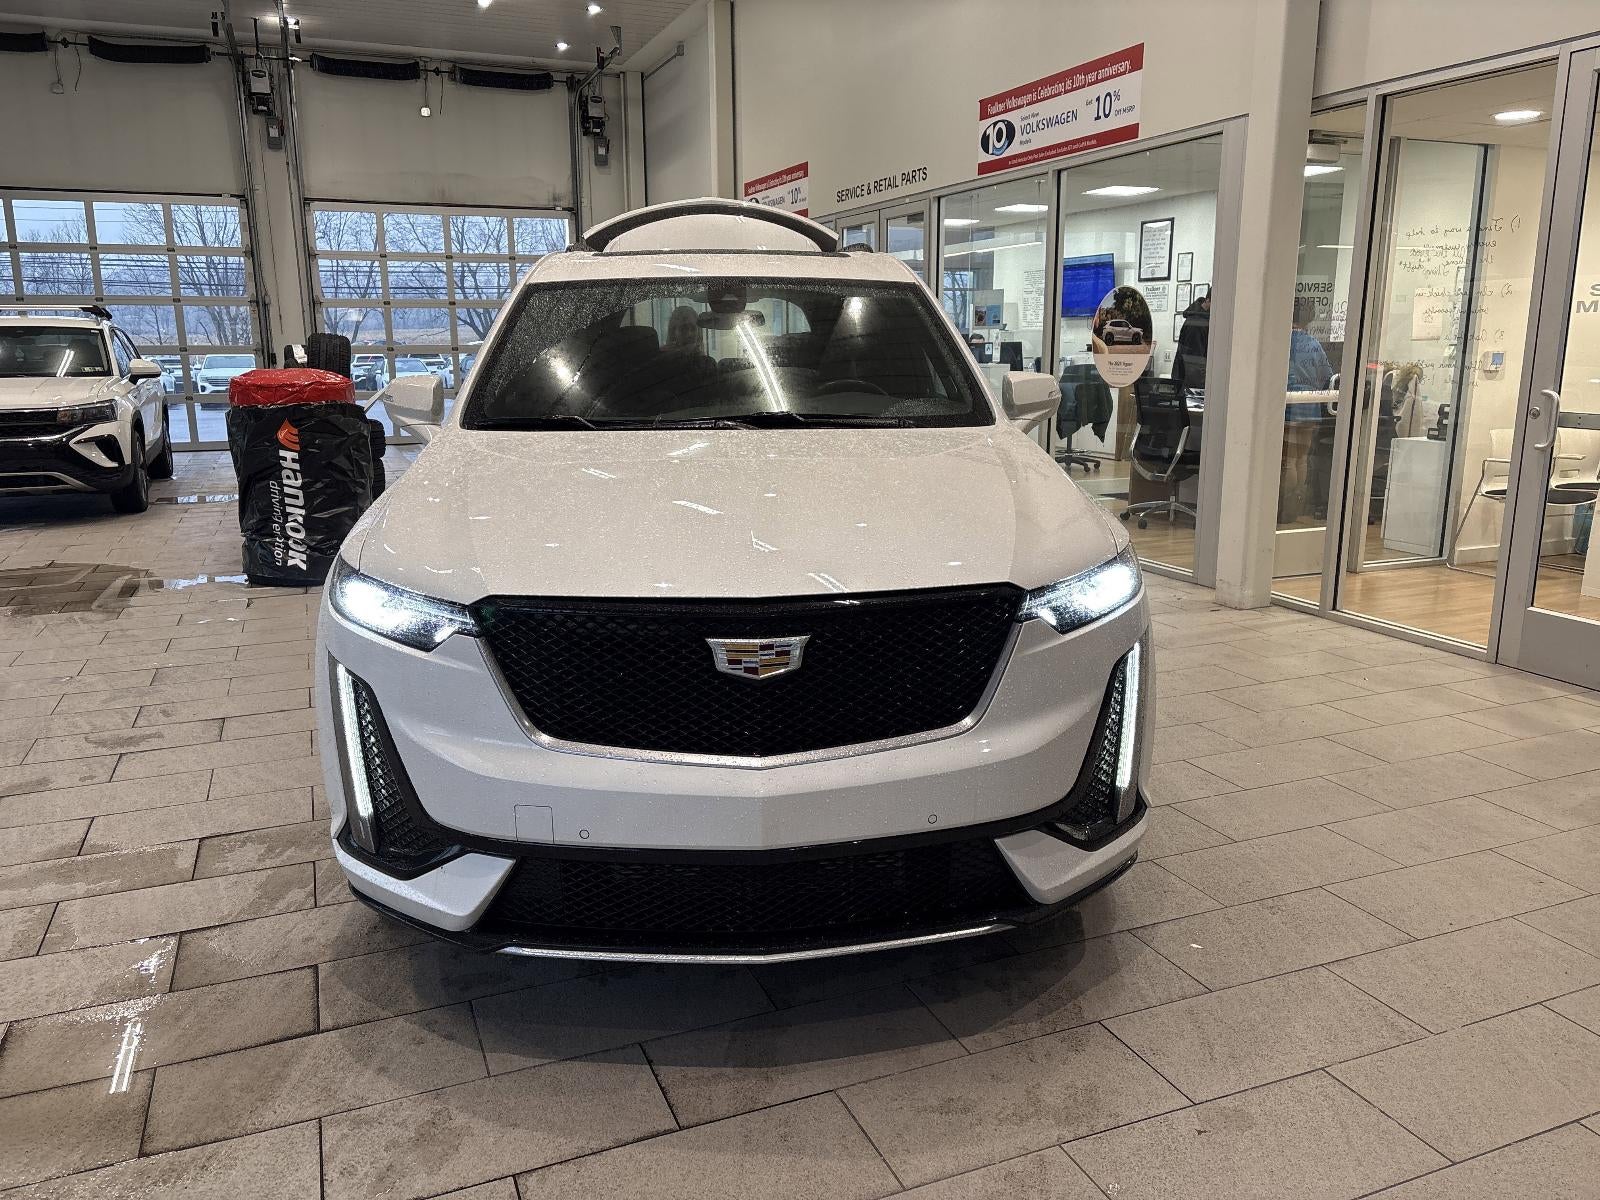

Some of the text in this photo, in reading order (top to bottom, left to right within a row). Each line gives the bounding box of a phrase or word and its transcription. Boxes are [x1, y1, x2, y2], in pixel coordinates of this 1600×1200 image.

[1005, 91, 1033, 110] Volkswagen
[1037, 81, 1065, 101] Celebrating
[1072, 73, 1085, 88] 10th
[1085, 70, 1097, 88] year
[1020, 109, 1078, 137] VOLKSWAGEN
[1122, 104, 1135, 115] MSRP
[985, 121, 1008, 155] 10
[836, 166, 928, 203] SERVICE & RETAIL PARTS
[269, 480, 286, 567] driving etion
[278, 449, 307, 572] Hankook
